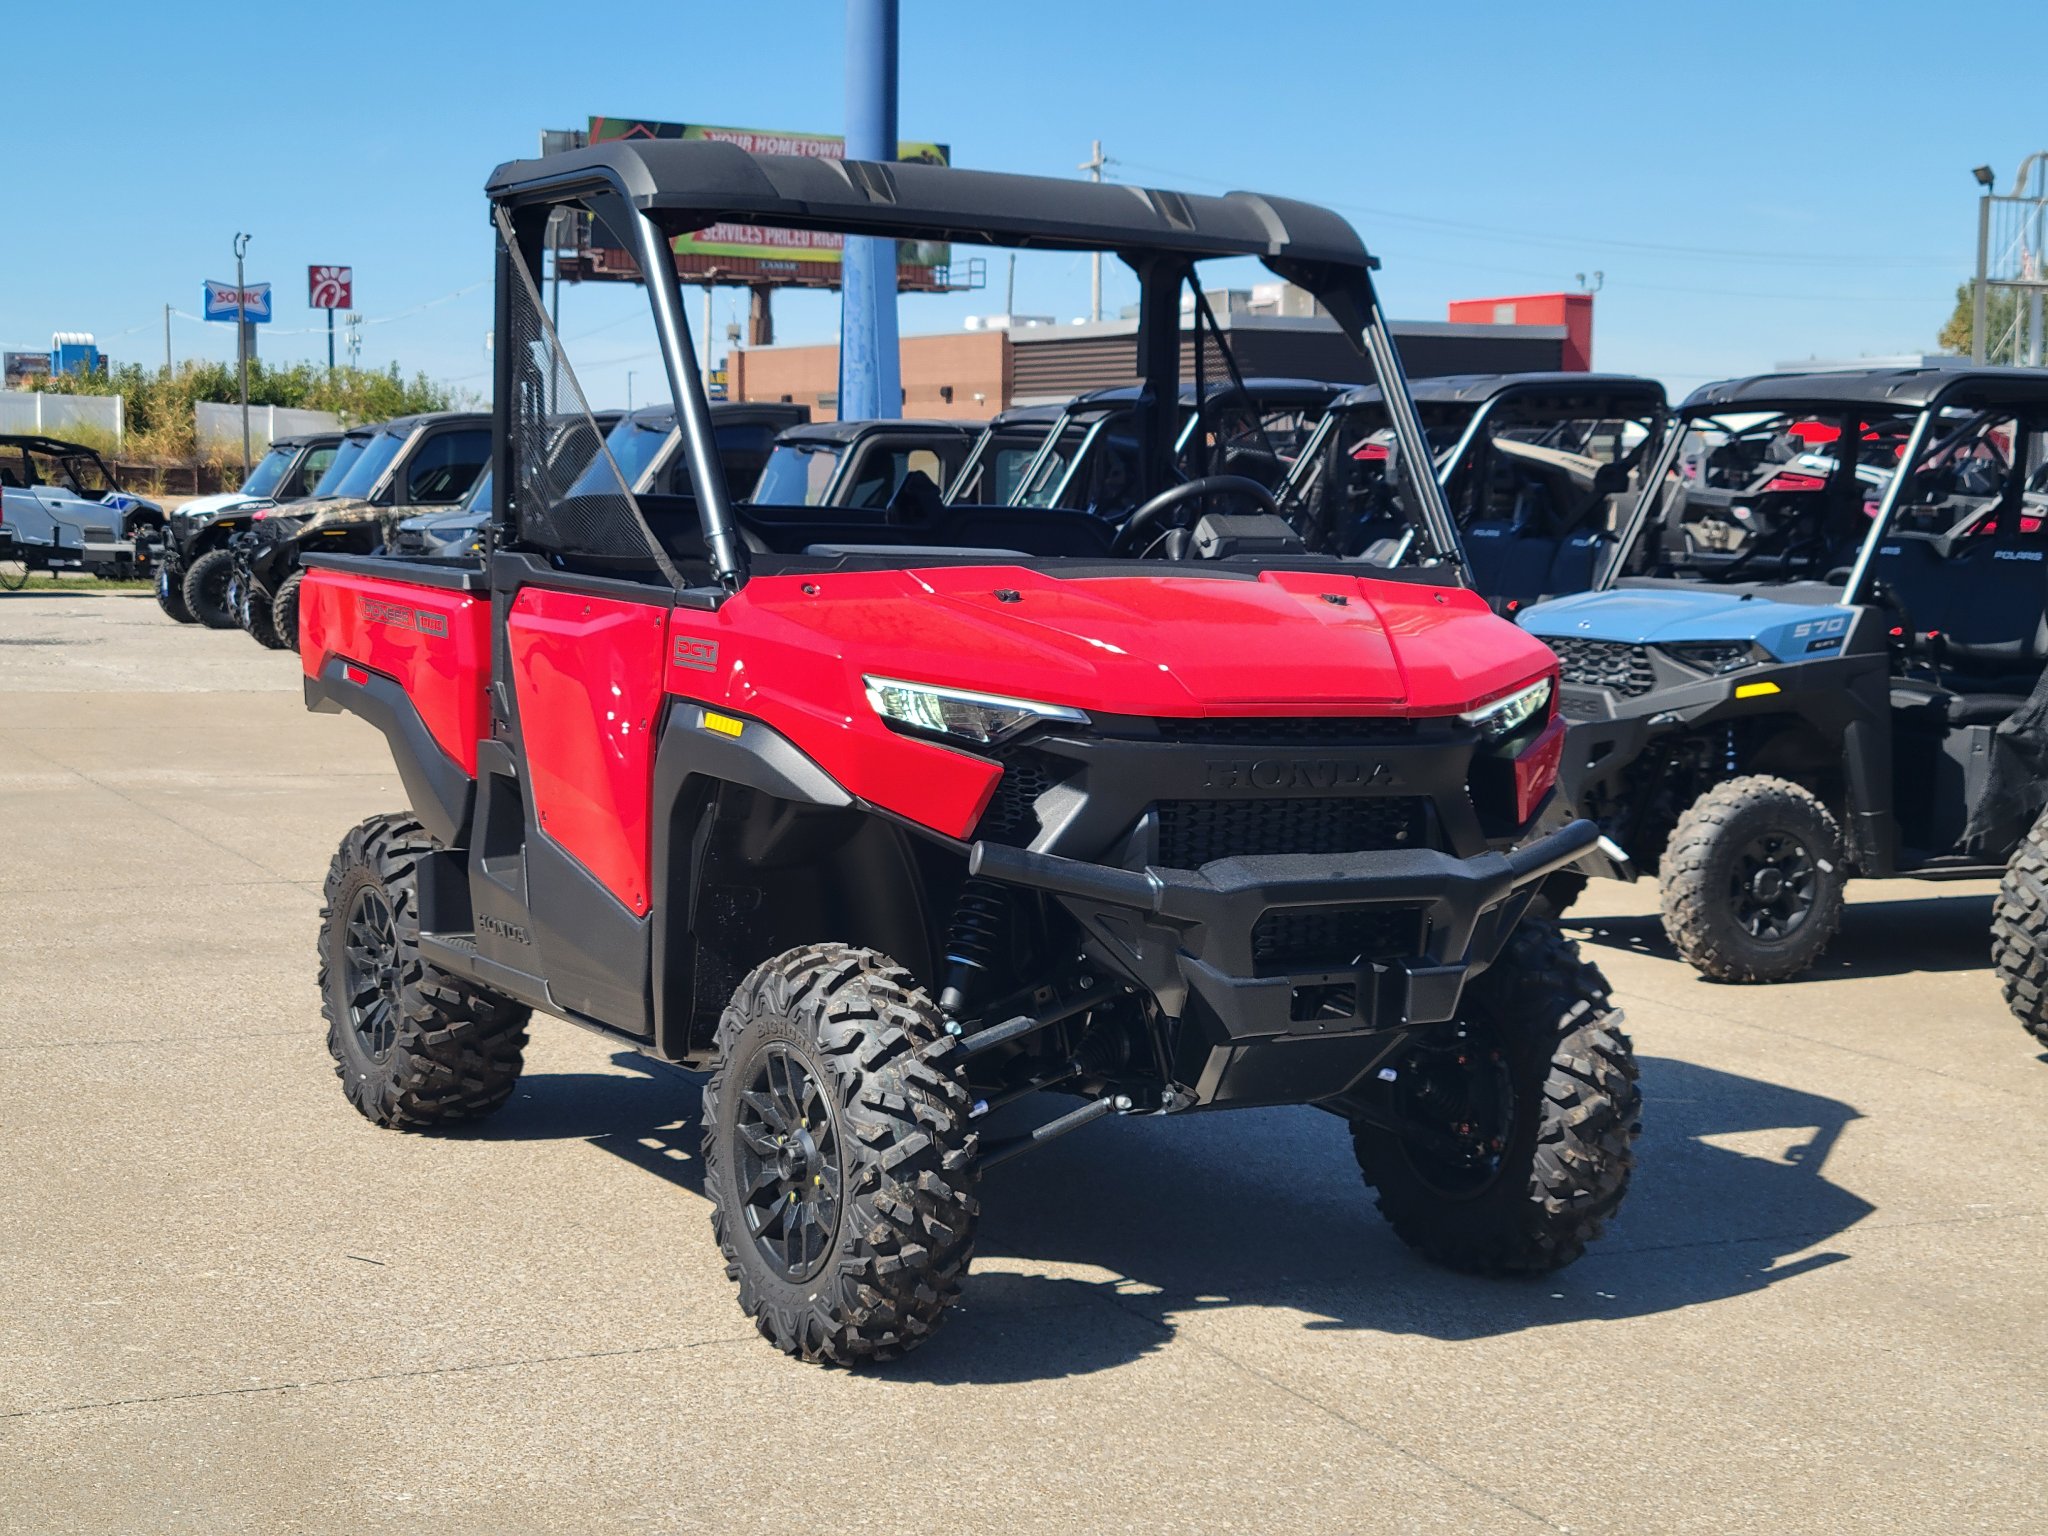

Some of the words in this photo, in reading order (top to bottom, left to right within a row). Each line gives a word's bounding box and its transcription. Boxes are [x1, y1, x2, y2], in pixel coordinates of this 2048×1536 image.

[755, 136, 844, 157] HOMETOWN
[1993, 551, 2043, 561] POLARIS
[1793, 618, 1845, 638] 570
[677, 640, 716, 659] DCT
[1203, 758, 1405, 790] HONDA
[478, 912, 531, 945] HONDA
